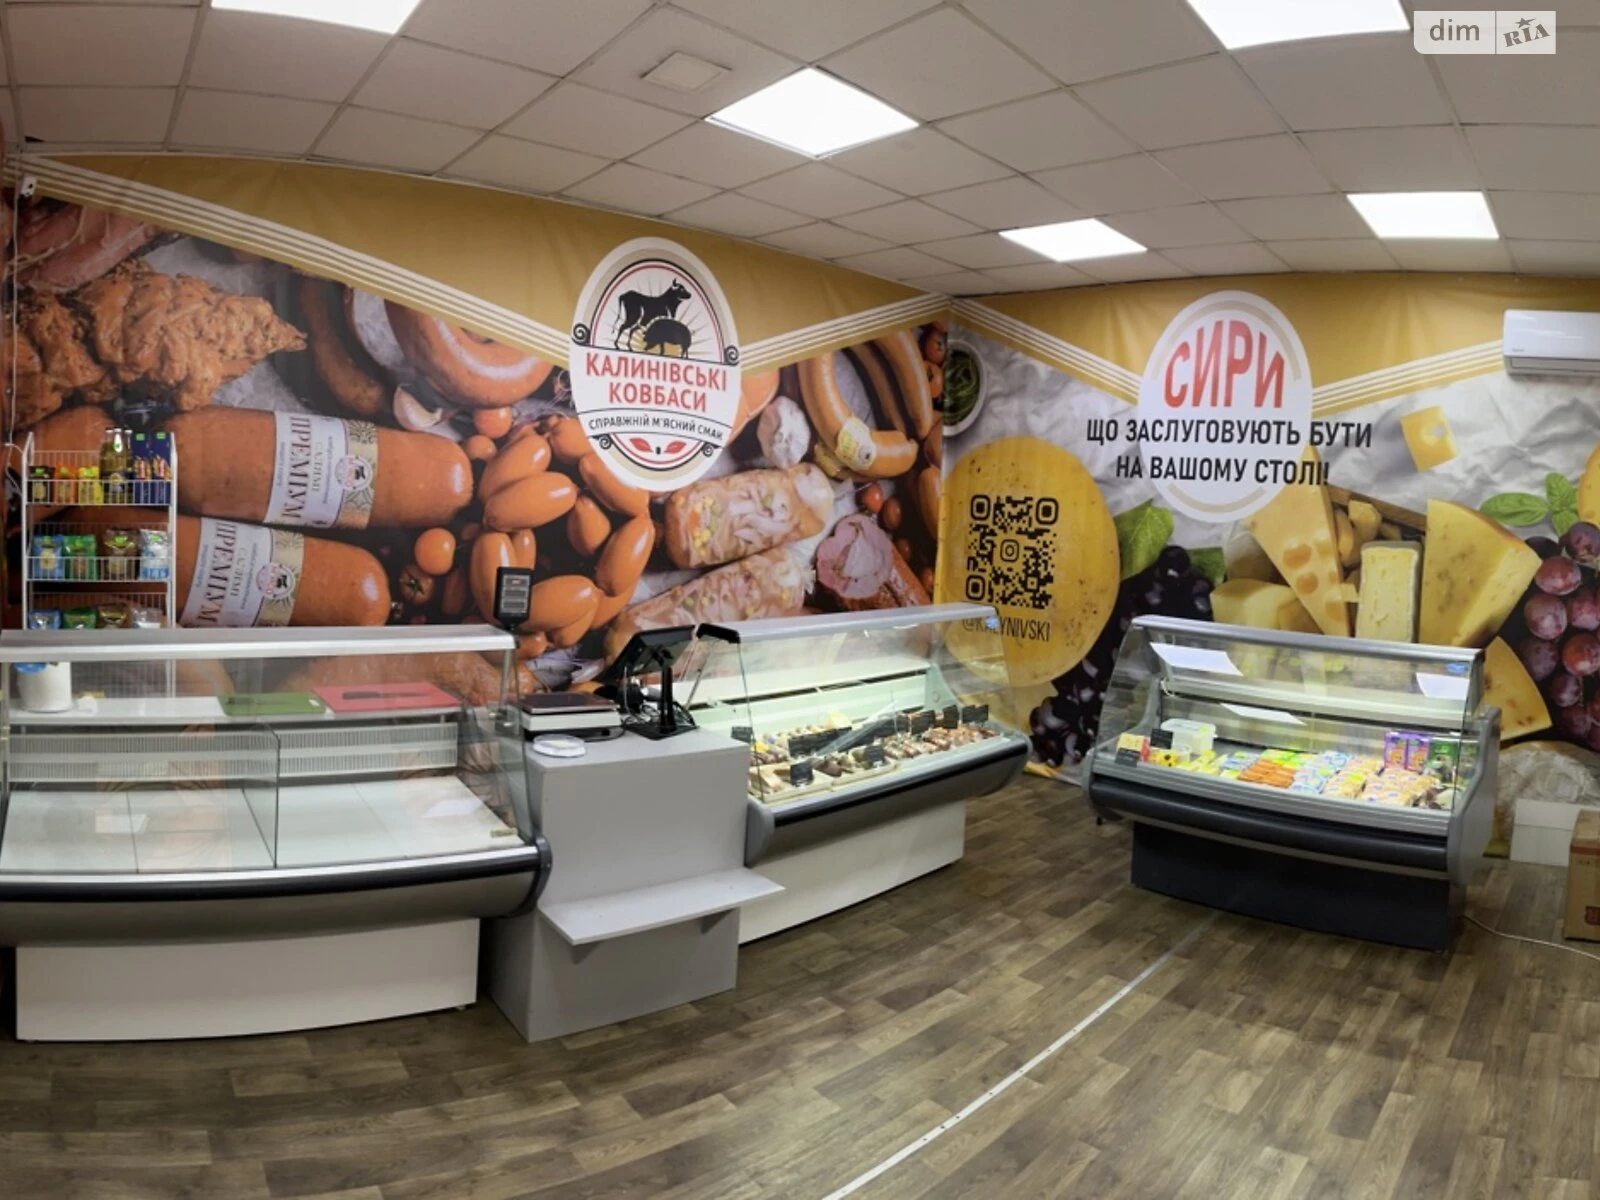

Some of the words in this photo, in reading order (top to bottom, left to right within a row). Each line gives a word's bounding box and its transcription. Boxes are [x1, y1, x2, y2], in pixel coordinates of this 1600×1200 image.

[585, 352, 727, 392] КАЛИНІВСЬКІ
[1163, 319, 1285, 409] СИРИ
[608, 382, 707, 413] КОВБАСИ
[588, 414, 650, 431] СПРАВЖНІЙ
[697, 424, 724, 441] СМАК
[1086, 418, 1119, 446] ЩО
[1125, 418, 1301, 446] ЗАСЛУГОВУЮТЬ
[1309, 421, 1373, 449] БУТИ
[281, 416, 311, 519] ПРЕМІУМ
[1115, 455, 1143, 479] НА
[1150, 455, 1248, 483] ВАШОМУ
[1254, 459, 1330, 487] СТОЛІ!
[196, 521, 237, 623] ПРЕМІУМ
[961, 615, 1051, 642] @KYNIVSKI
